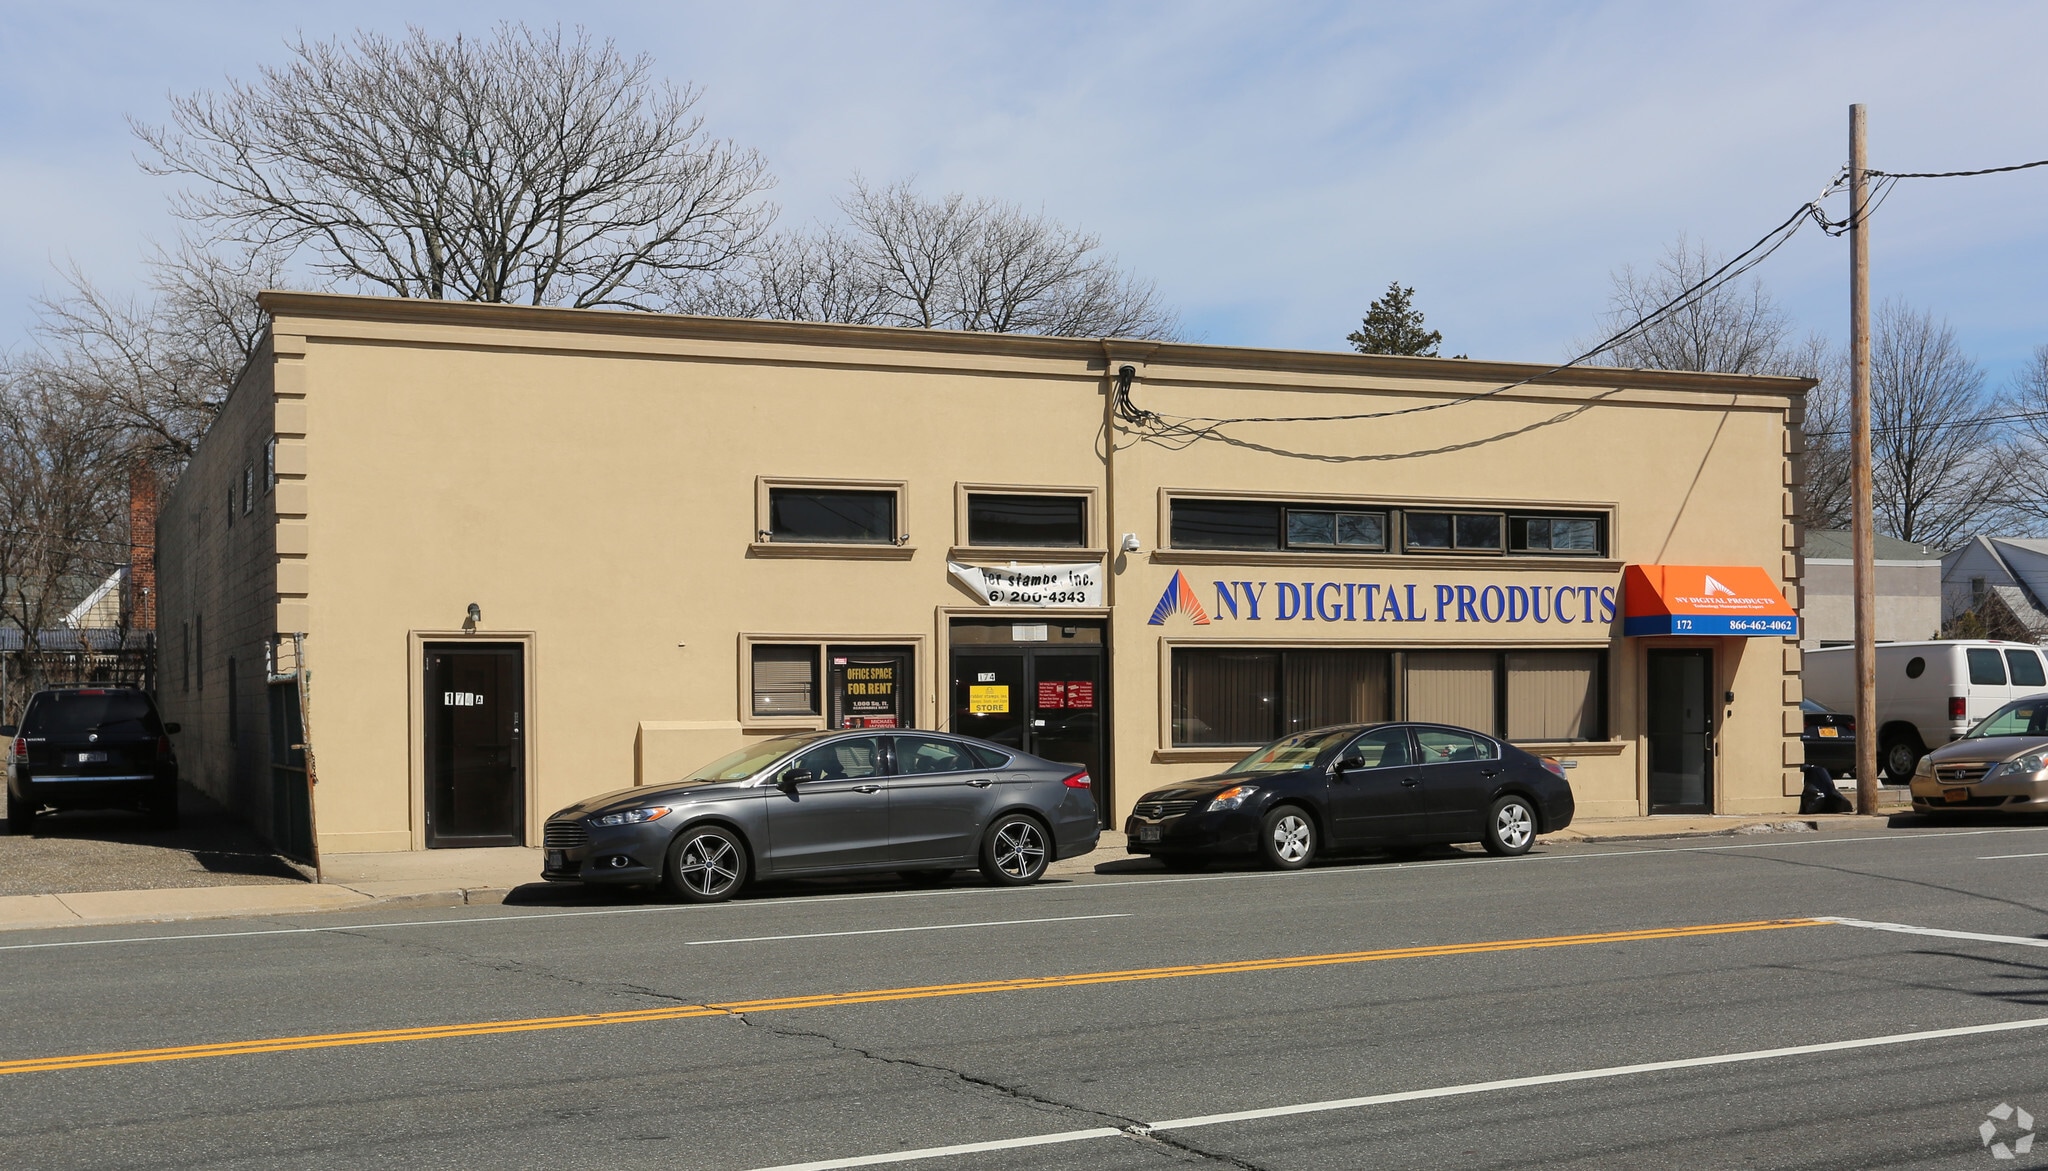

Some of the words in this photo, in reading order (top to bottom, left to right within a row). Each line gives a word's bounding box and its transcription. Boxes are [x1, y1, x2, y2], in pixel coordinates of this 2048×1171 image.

[1069, 570, 1093, 587] inc.
[1010, 591, 1086, 603] 200-4343
[1213, 581, 1267, 621] NY
[1275, 582, 1427, 622] DIGITAL
[1434, 584, 1618, 624] PRODUCTS
[1727, 597, 1775, 605] PRODUCTS
[1676, 620, 1692, 630] 172
[1729, 620, 1792, 630] 866-462-4062
[847, 668, 870, 680] OFFICE
[870, 668, 892, 680] SPACE
[847, 683, 866, 695] FOR
[867, 683, 892, 694] RENT
